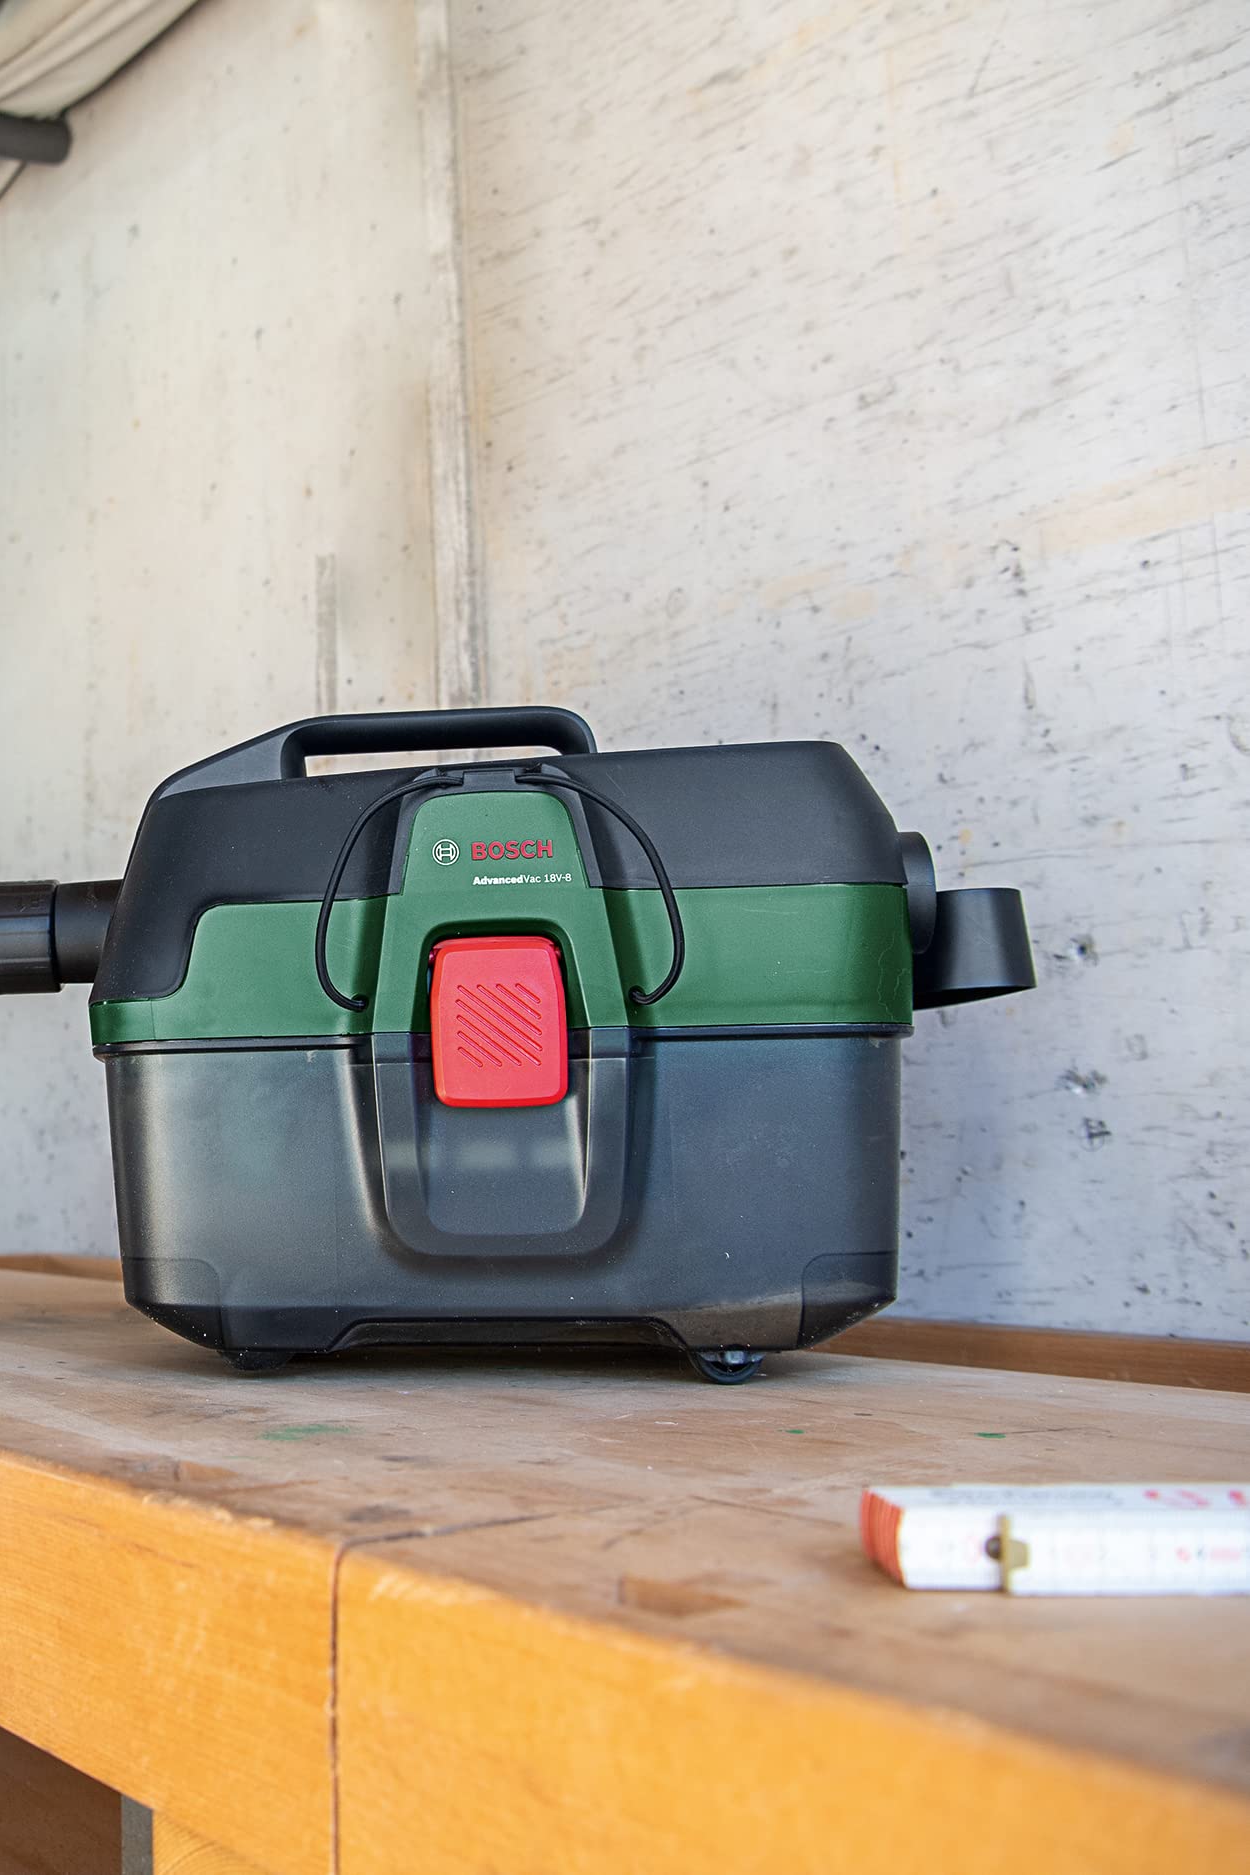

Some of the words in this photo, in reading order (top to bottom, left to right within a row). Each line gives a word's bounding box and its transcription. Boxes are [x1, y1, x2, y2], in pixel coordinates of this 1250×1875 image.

[471, 840, 553, 860] BOSCH
[472, 874, 541, 885] AdvancedVac
[544, 873, 572, 883] 18V-8
